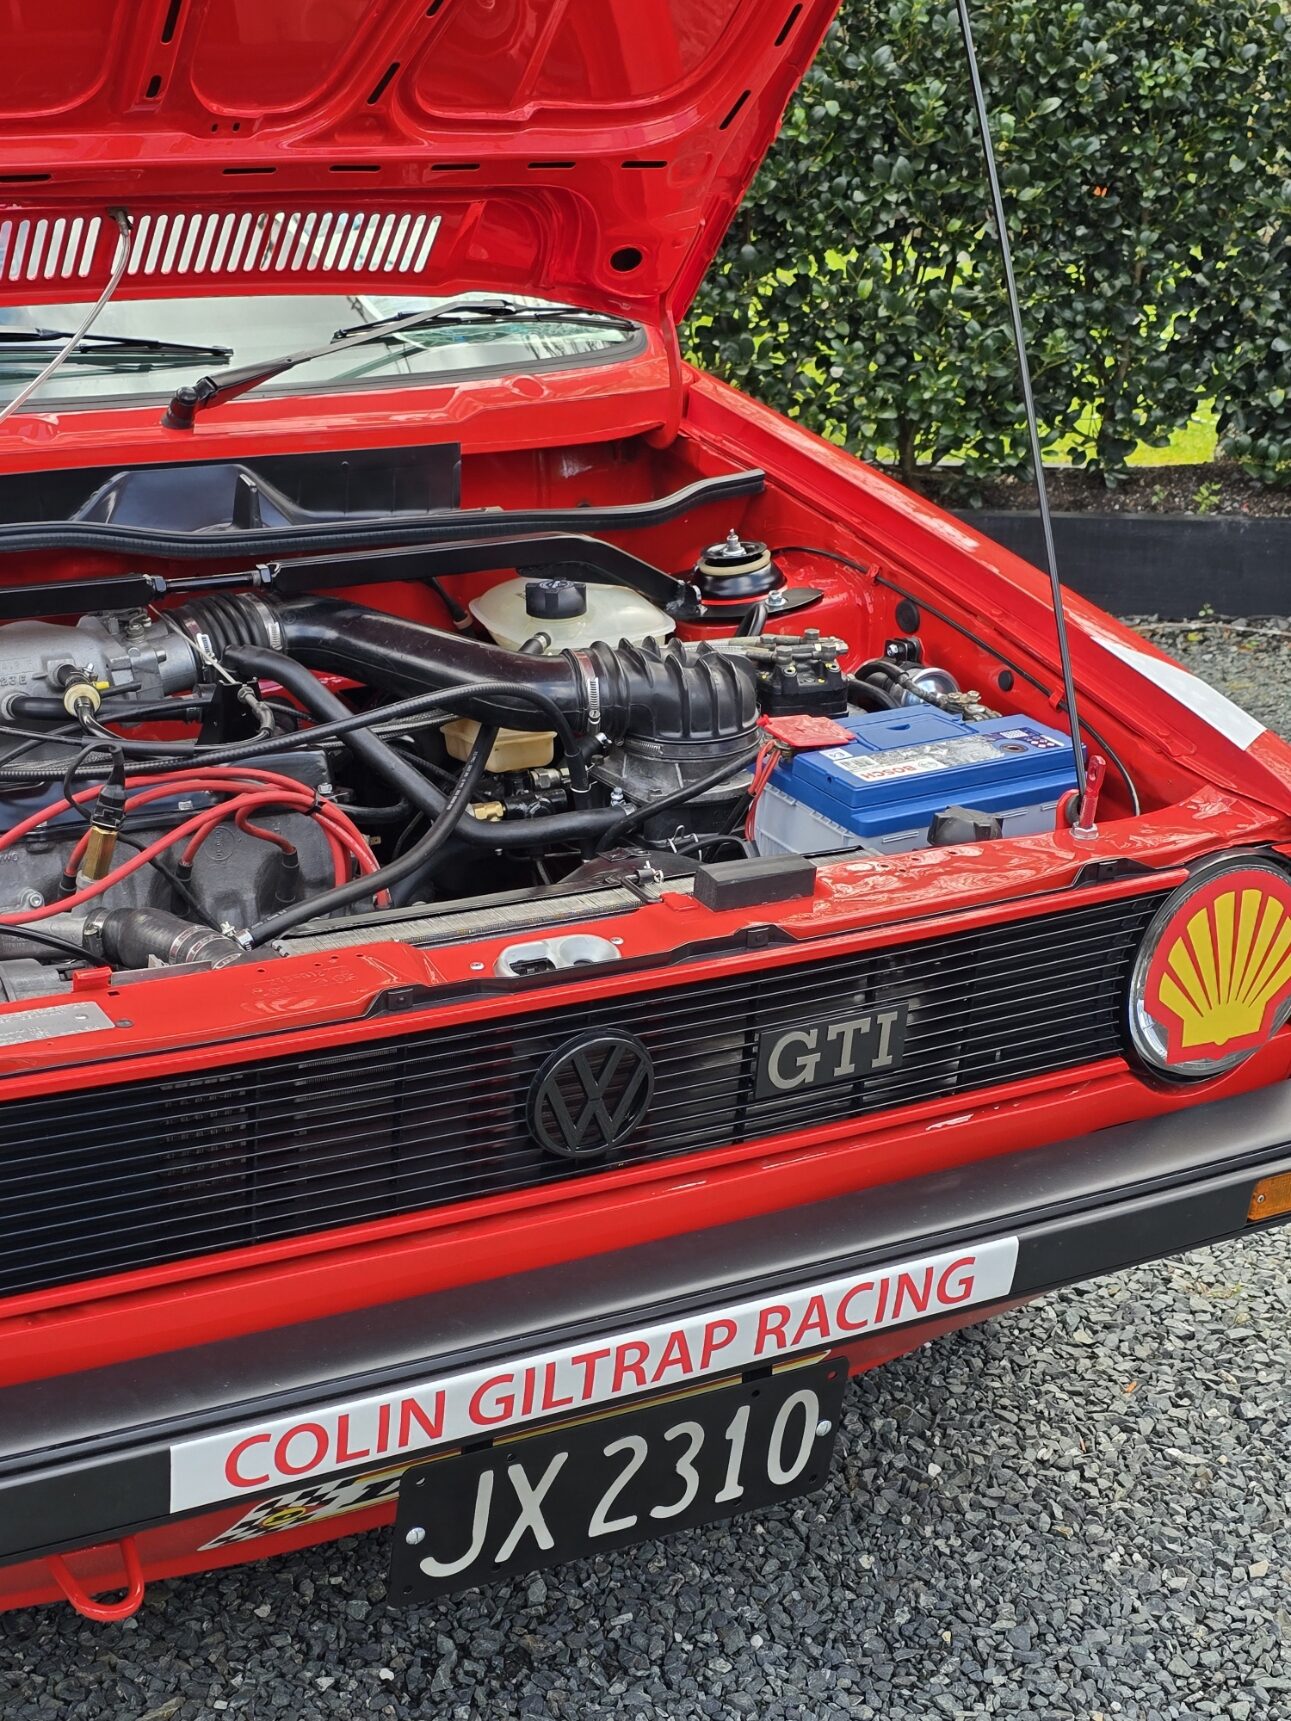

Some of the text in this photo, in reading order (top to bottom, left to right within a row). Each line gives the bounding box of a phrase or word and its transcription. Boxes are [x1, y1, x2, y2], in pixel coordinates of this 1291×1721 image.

[860, 764, 917, 779] BOSCH
[535, 1036, 650, 1154] VW
[767, 1010, 900, 1091] GTI
[225, 1256, 976, 1488] COLIN GILTRAP RACING
[419, 1387, 820, 1579] JX 2310
